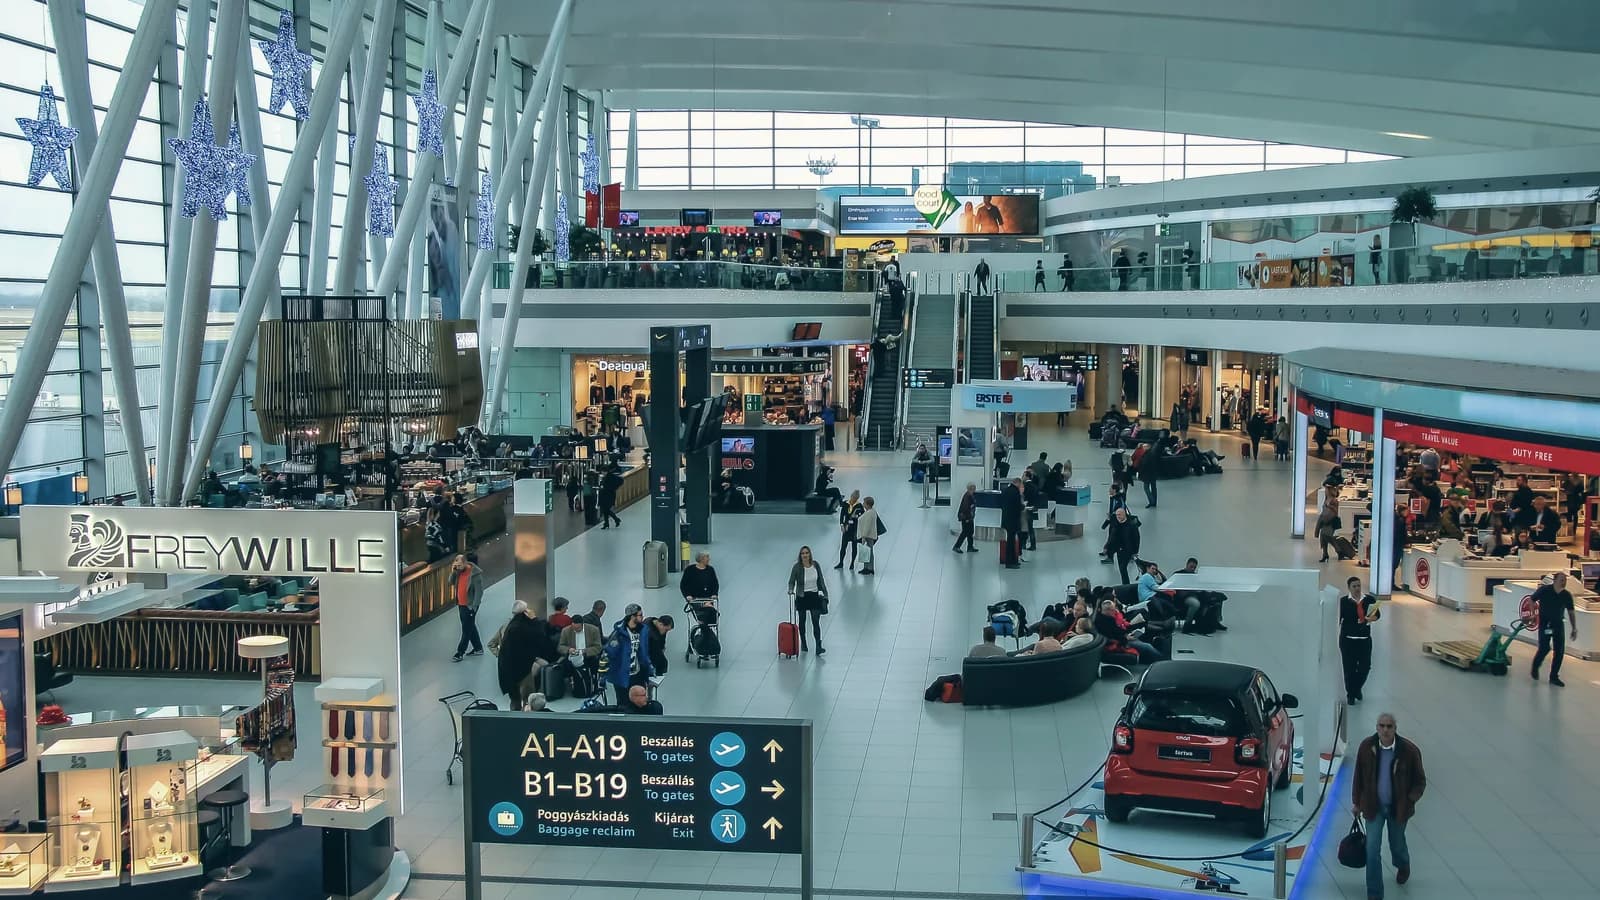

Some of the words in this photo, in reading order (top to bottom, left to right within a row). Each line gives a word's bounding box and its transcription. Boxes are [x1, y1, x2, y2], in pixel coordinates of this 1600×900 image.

[917, 190, 937, 198] food
[645, 226, 691, 234] LEROY
[600, 360, 648, 372] Desigual
[976, 394, 1001, 403] ERSTE
[1421, 432, 1441, 443] TRAVEL
[1441, 436, 1459, 446] VALUE
[1512, 447, 1531, 458] DUTY
[1534, 451, 1553, 461] FREE
[127, 535, 384, 574] FREYWILLE
[641, 735, 694, 747] Beszállás
[644, 750, 658, 761] To
[661, 752, 694, 764] gates
[641, 774, 695, 786] Beszállás
[644, 789, 659, 800] To
[662, 790, 695, 802] gates
[537, 809, 630, 822] Poggyászkiadás
[655, 812, 695, 826] Kijárat
[538, 824, 590, 837] Baggage
[592, 826, 635, 837] reclaim
[672, 828, 695, 838] Exit
